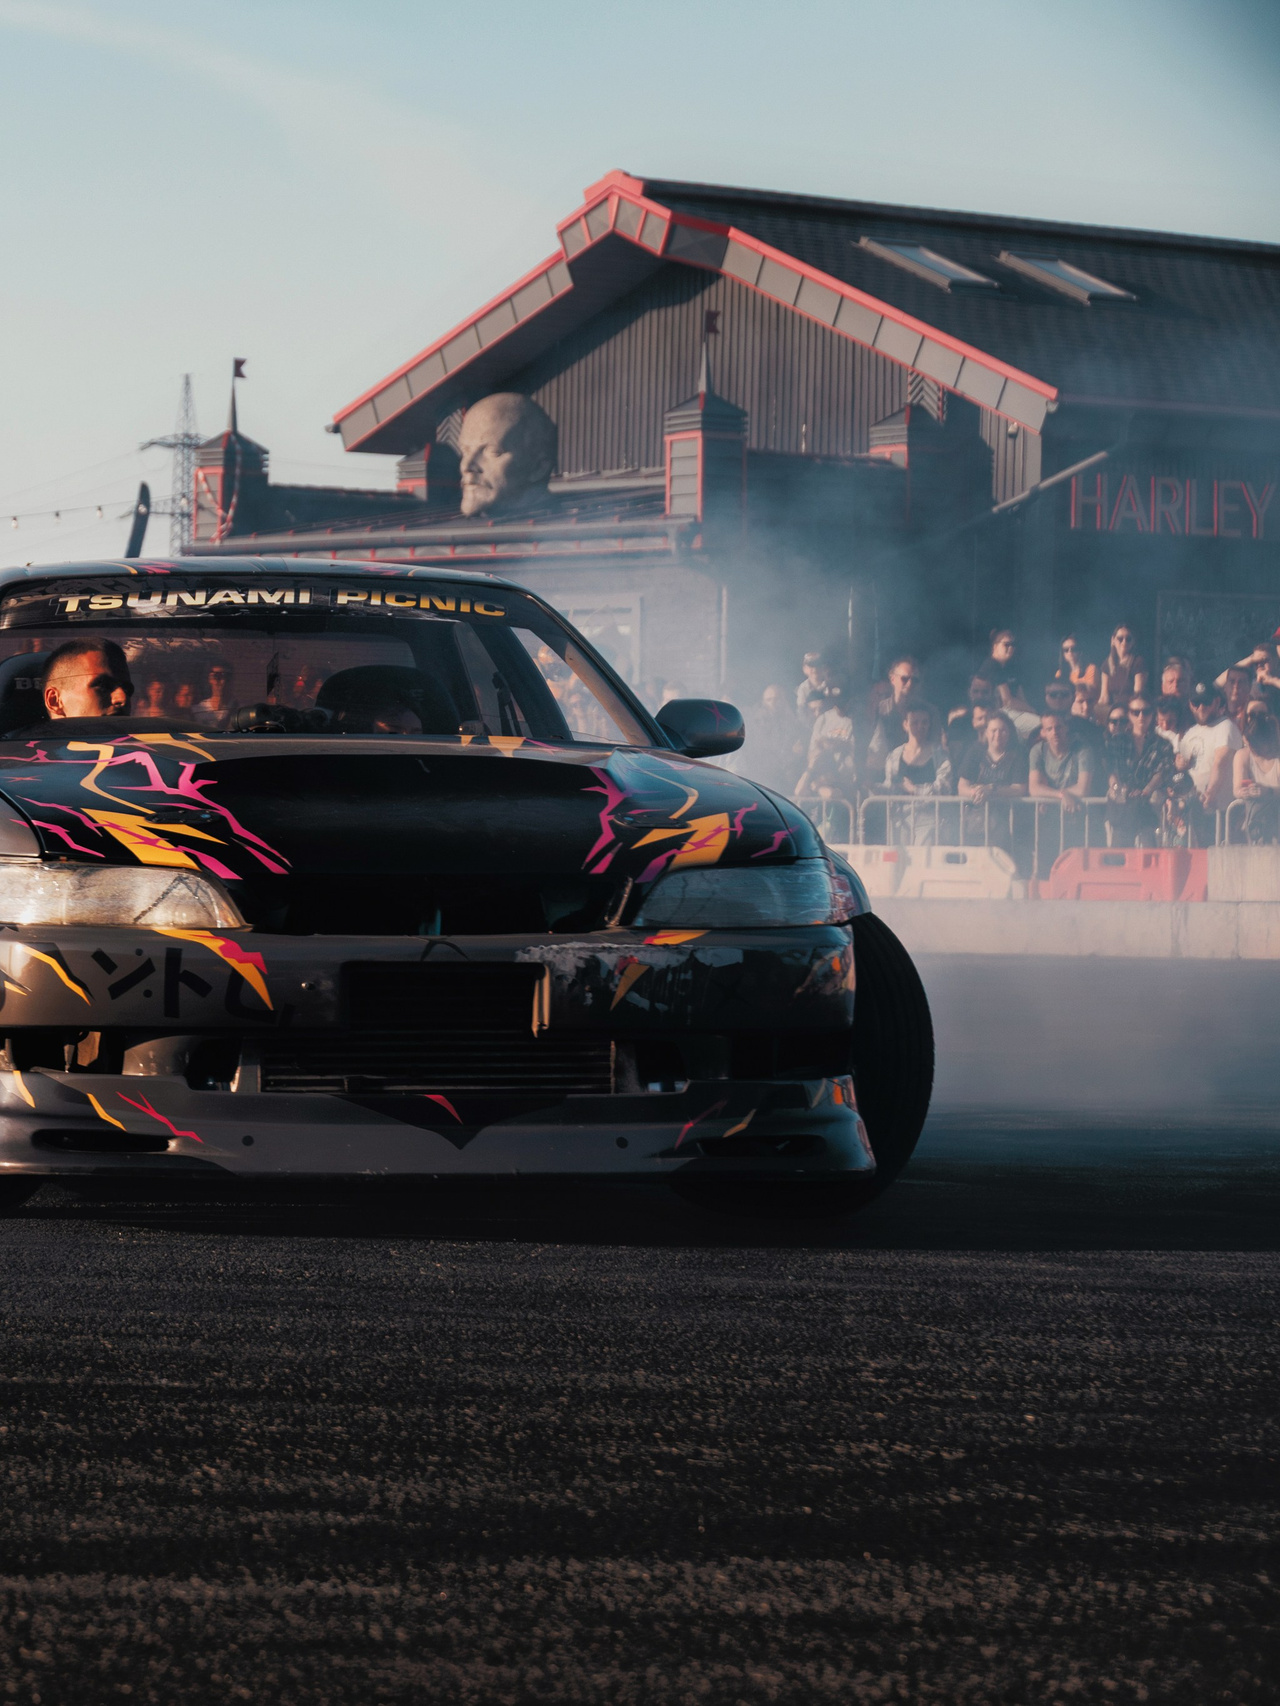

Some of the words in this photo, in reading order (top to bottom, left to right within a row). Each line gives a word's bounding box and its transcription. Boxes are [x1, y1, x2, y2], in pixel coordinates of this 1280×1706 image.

[1070, 473, 1278, 538] HARLEY
[58, 588, 311, 612] TSUNAMI
[336, 588, 506, 617] PICNIC
